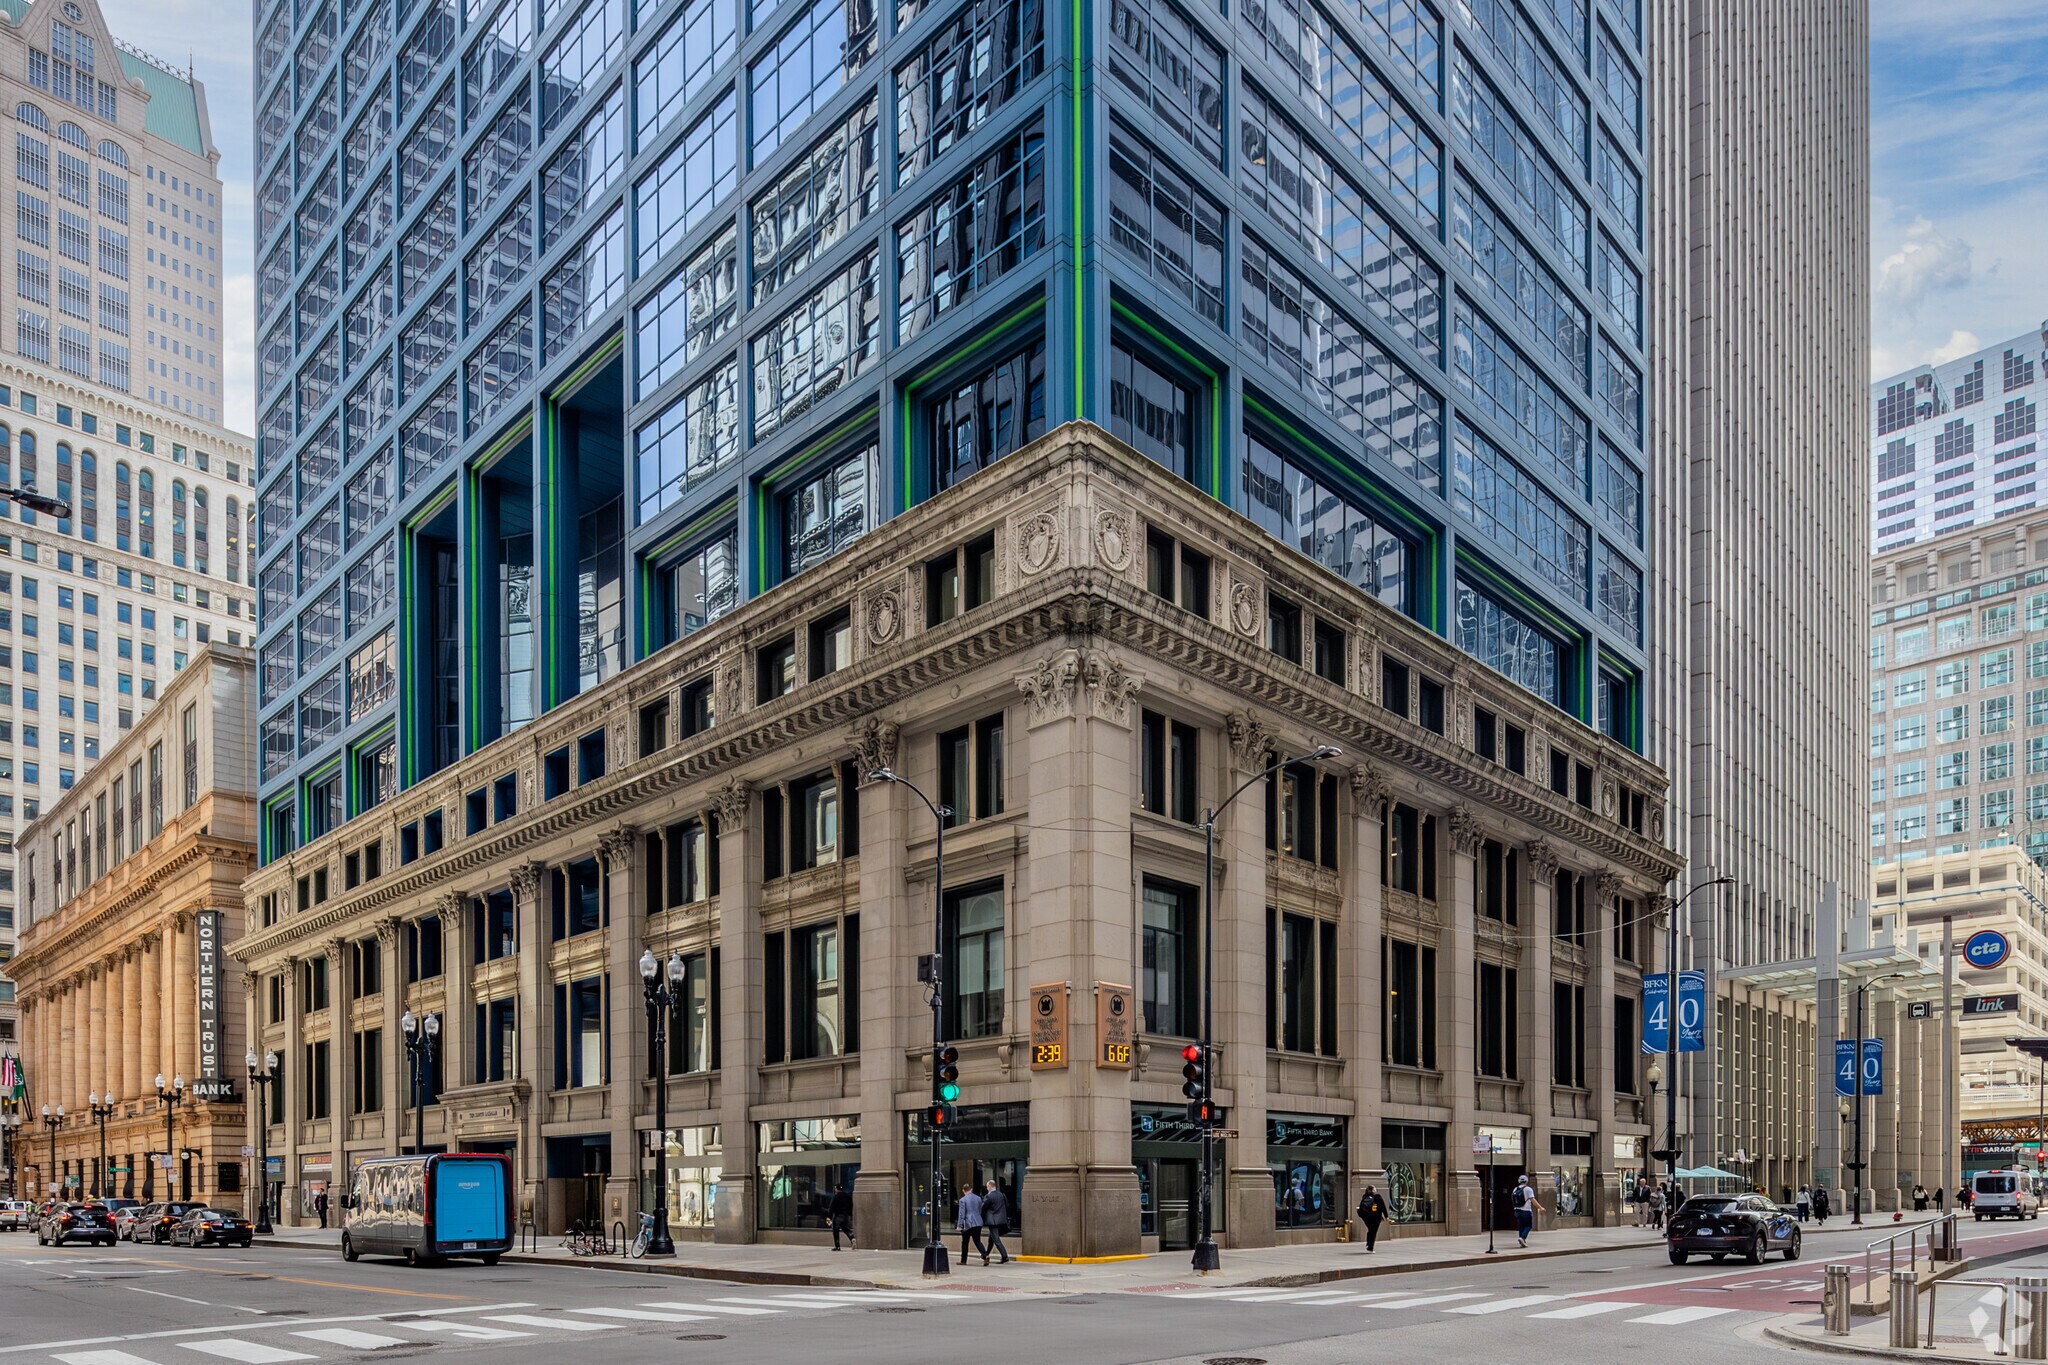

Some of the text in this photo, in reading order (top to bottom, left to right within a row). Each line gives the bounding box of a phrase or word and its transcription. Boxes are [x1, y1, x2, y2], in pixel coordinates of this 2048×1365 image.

[1970, 942, 2000, 957] cta
[1644, 979, 1668, 989] BFKN
[200, 915, 215, 1077] NORTHERN TRUST
[1037, 1044, 1061, 1063] 2:39
[192, 1083, 232, 1095] BANK
[1155, 1120, 1174, 1129] FIFTH
[1174, 1120, 1195, 1130] THIRD
[1286, 1127, 1334, 1136] FIFTH THIRD BANK
